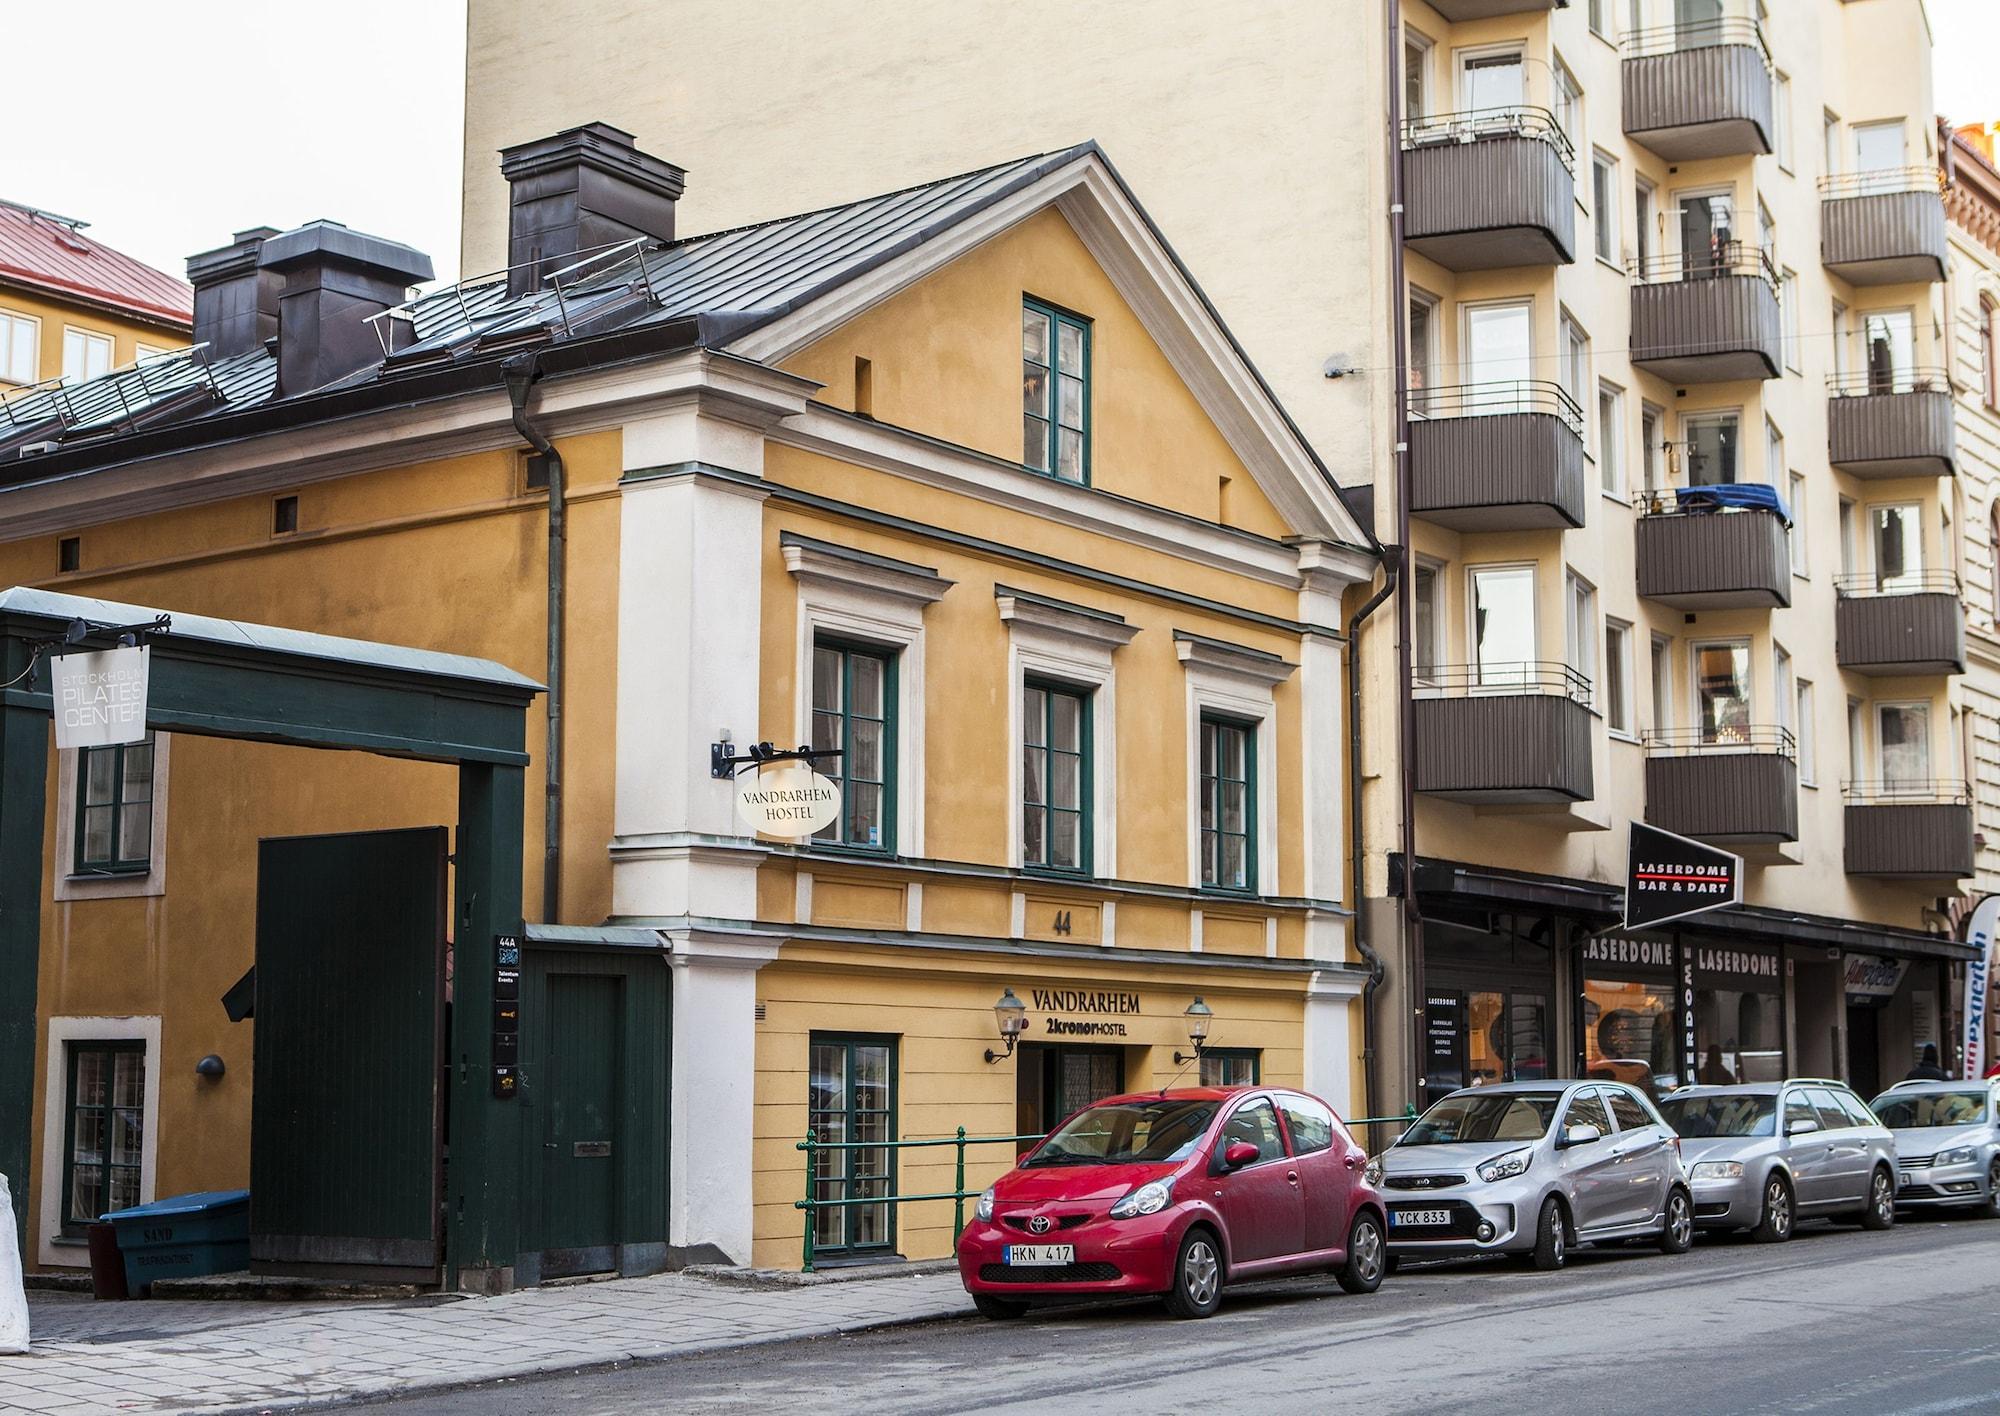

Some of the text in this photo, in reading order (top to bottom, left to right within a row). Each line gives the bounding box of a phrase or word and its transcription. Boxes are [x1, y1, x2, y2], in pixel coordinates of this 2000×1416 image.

[63, 681, 142, 706] PILATES
[65, 702, 141, 728] CENTER
[743, 788, 832, 804] VANDRARHEM
[766, 806, 814, 820] HOSTEL
[1638, 863, 1728, 876] LASERDOME
[1638, 881, 1727, 893] BAR & DART
[1053, 910, 1071, 936] 44
[499, 937, 516, 947] 44A
[1699, 948, 1778, 977] LASERDOME
[1032, 989, 1140, 1014] VANDRARHEM
[1398, 1211, 1446, 1224] YCK 833
[144, 1227, 173, 1243] SAND
[1012, 1246, 1070, 1261] HKN 417
